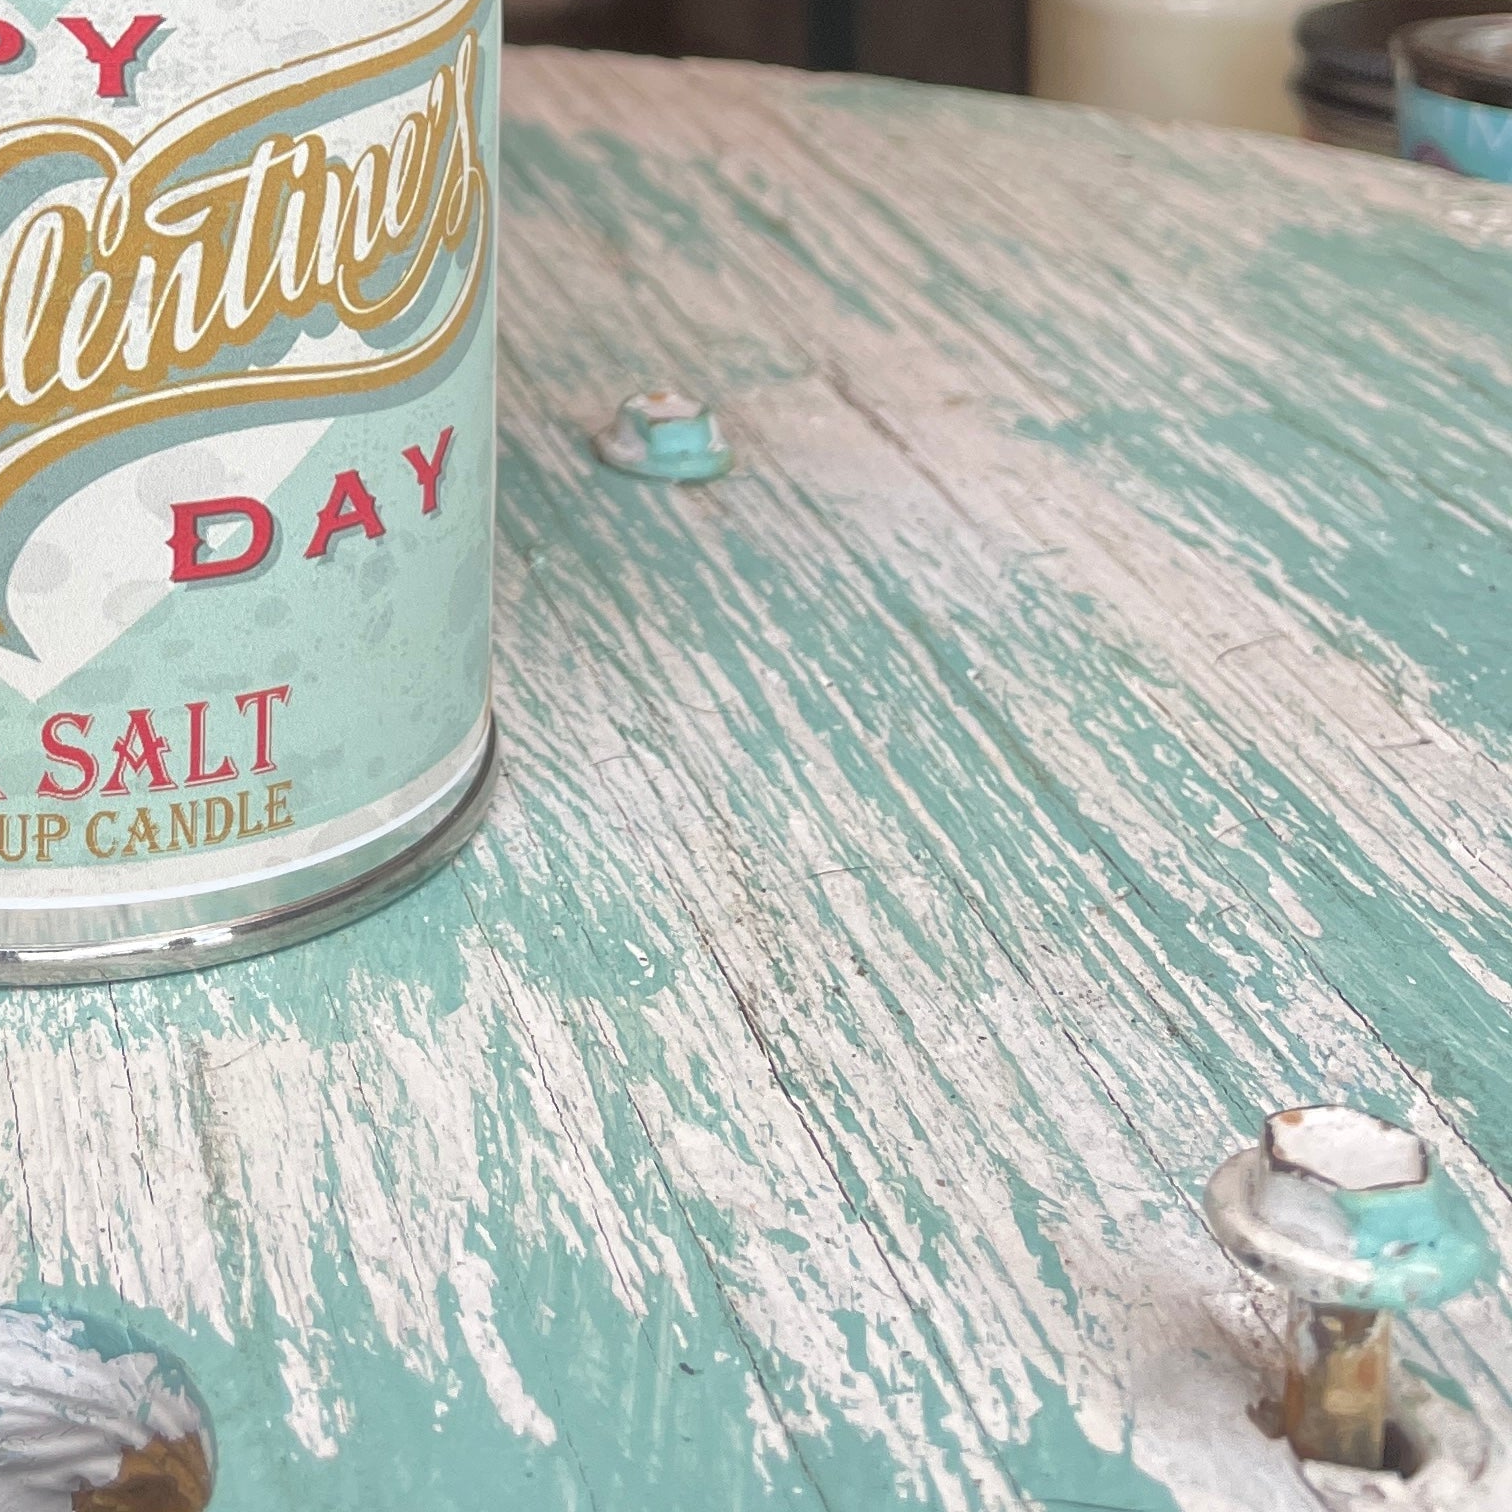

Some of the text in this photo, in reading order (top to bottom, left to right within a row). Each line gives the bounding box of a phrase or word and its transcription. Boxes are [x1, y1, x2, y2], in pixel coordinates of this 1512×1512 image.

[168, 425, 458, 584] DAY
[36, 685, 294, 801] SALT
[85, 780, 296, 859] CANDLE
